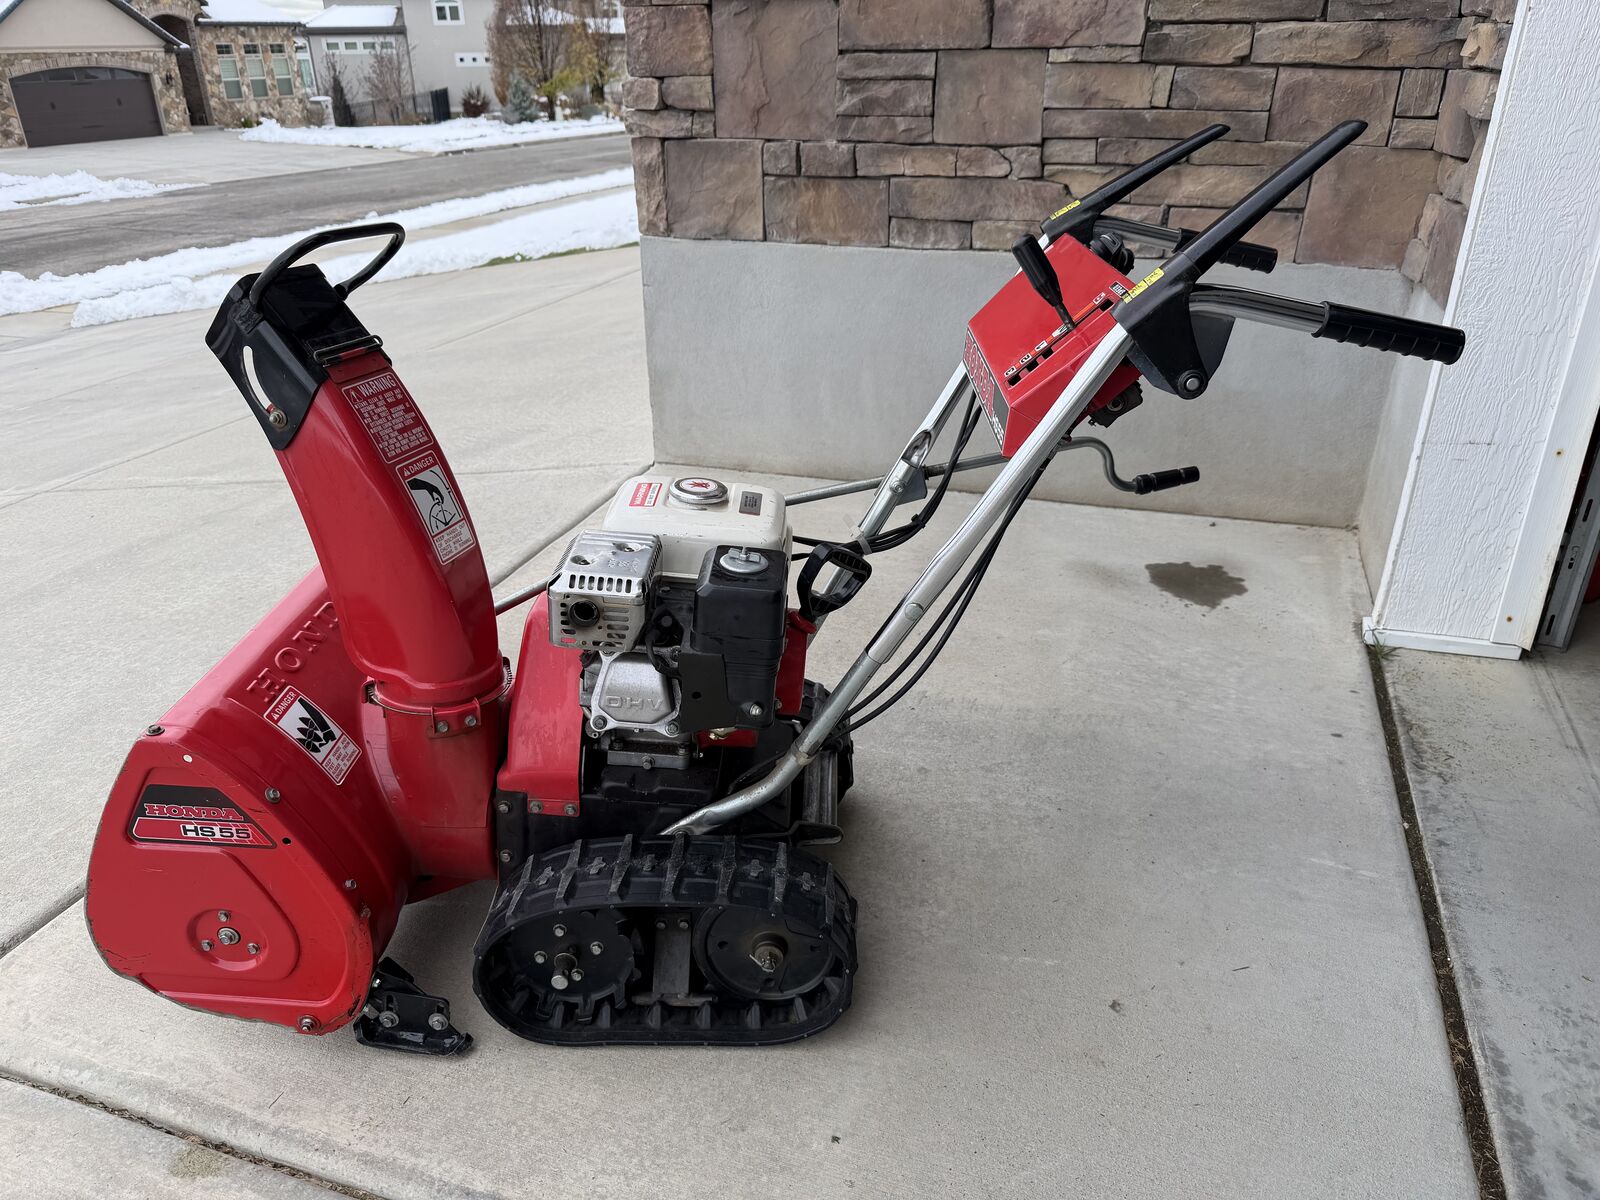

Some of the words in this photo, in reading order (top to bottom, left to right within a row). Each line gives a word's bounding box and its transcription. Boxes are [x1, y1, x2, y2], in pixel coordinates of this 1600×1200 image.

[357, 375, 397, 397] WARNING
[408, 456, 435, 473] DANGER
[275, 691, 297, 715] DANGER
[605, 695, 663, 711] OHV
[144, 803, 244, 821] HONDA
